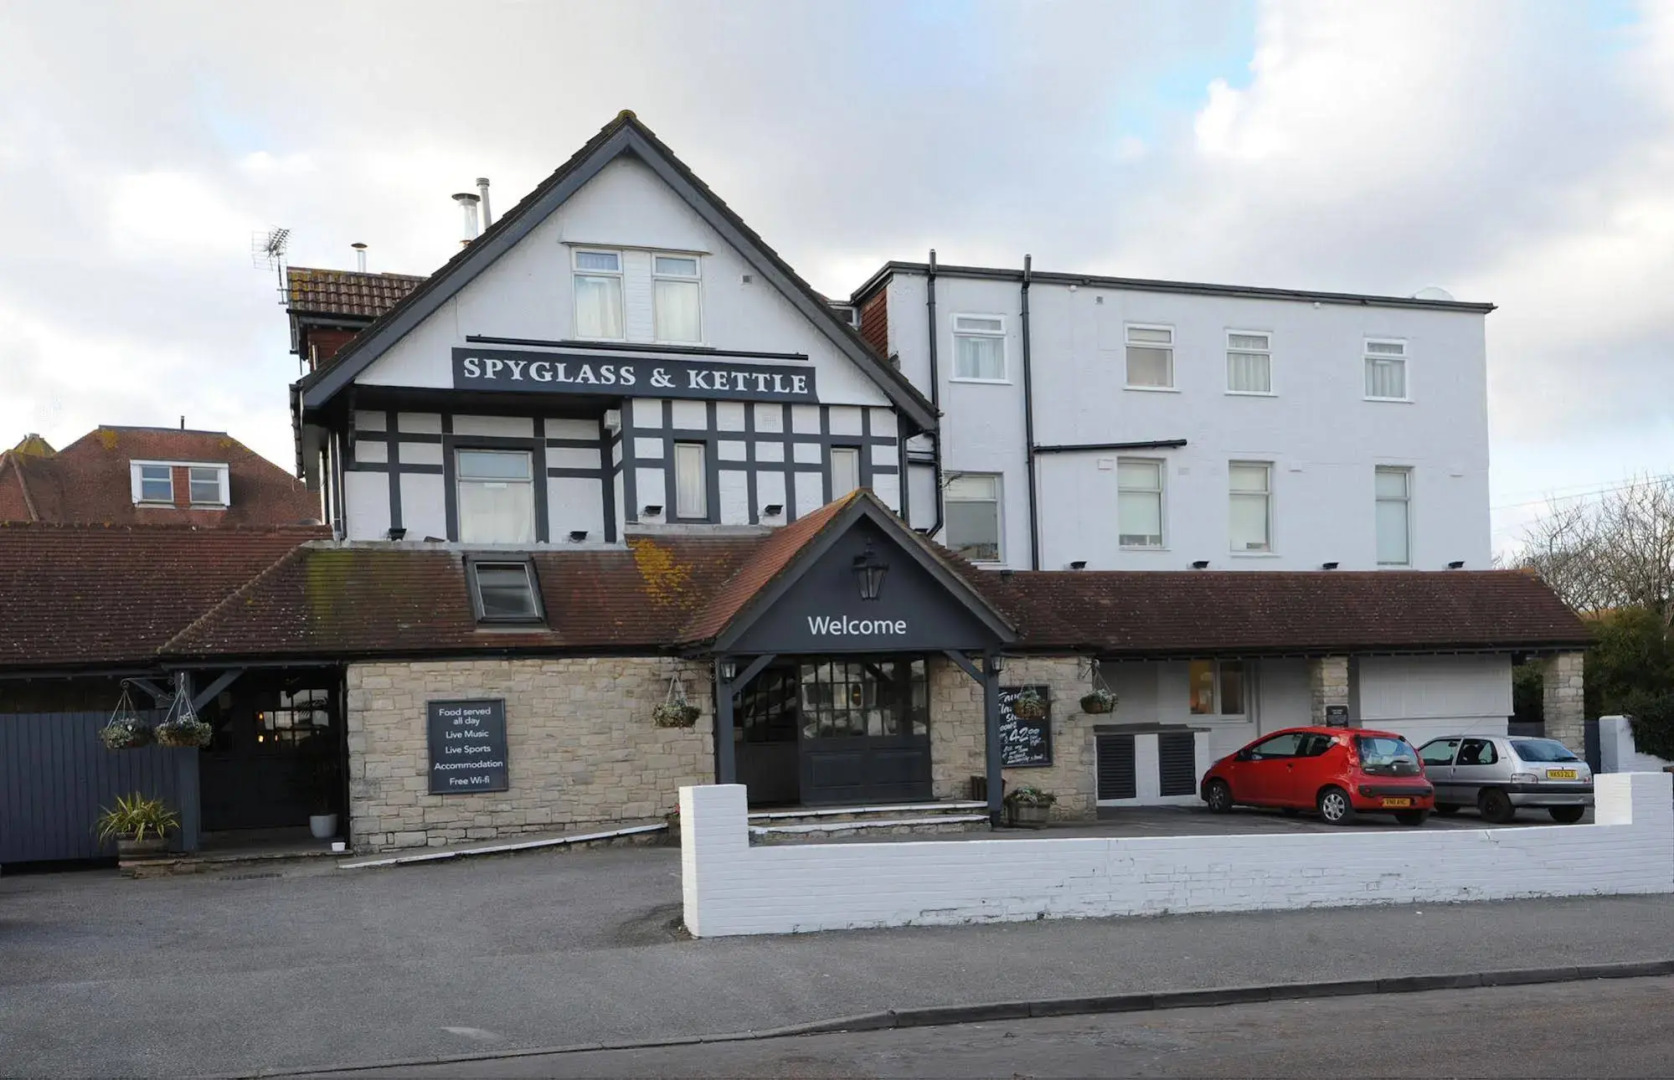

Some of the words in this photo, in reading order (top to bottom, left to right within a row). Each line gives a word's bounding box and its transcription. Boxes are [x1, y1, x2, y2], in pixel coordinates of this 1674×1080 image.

[463, 357, 636, 386] SPYGLASS
[650, 367, 676, 388] &
[688, 369, 809, 395] KETTLE
[807, 615, 907, 635] Welcome
[439, 708, 461, 716] Food
[463, 707, 491, 716] served
[453, 717, 463, 725] all
[465, 717, 480, 726] day
[446, 731, 462, 739] Live
[464, 730, 489, 738] Music
[445, 746, 462, 754] Live
[464, 745, 491, 755] Sports
[434, 760, 503, 770] Accommodation
[449, 777, 468, 785] Free
[470, 776, 490, 784] Wi-fi
